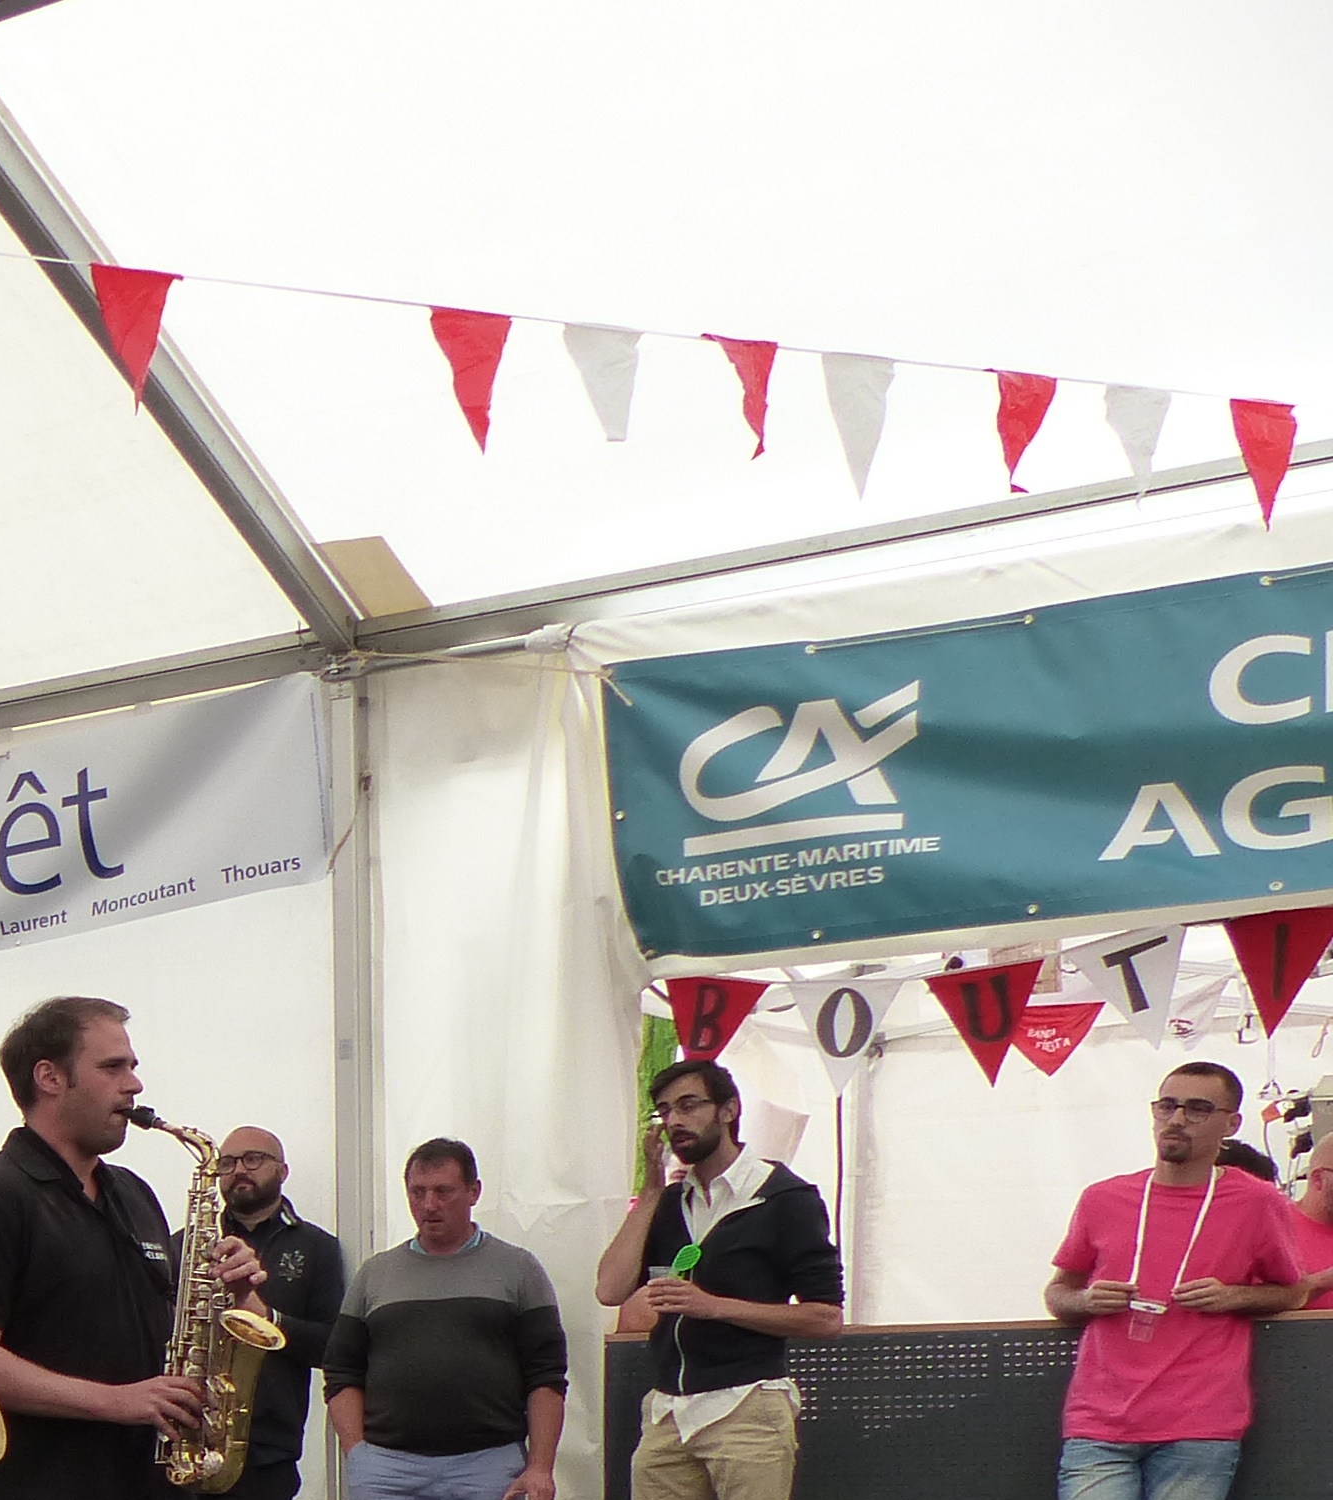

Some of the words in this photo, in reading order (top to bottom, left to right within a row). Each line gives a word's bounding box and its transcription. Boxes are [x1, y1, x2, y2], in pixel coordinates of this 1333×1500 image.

[1209, 629, 1333, 725] C
[679, 680, 920, 822] CA
[0, 909, 68, 937] Laurent
[90, 876, 197, 918] Moncoutant
[220, 855, 302, 886] Thouars
[656, 836, 941, 887] CHARENTE-MARITIME
[699, 865, 885, 907] DEUX-SÈVRES
